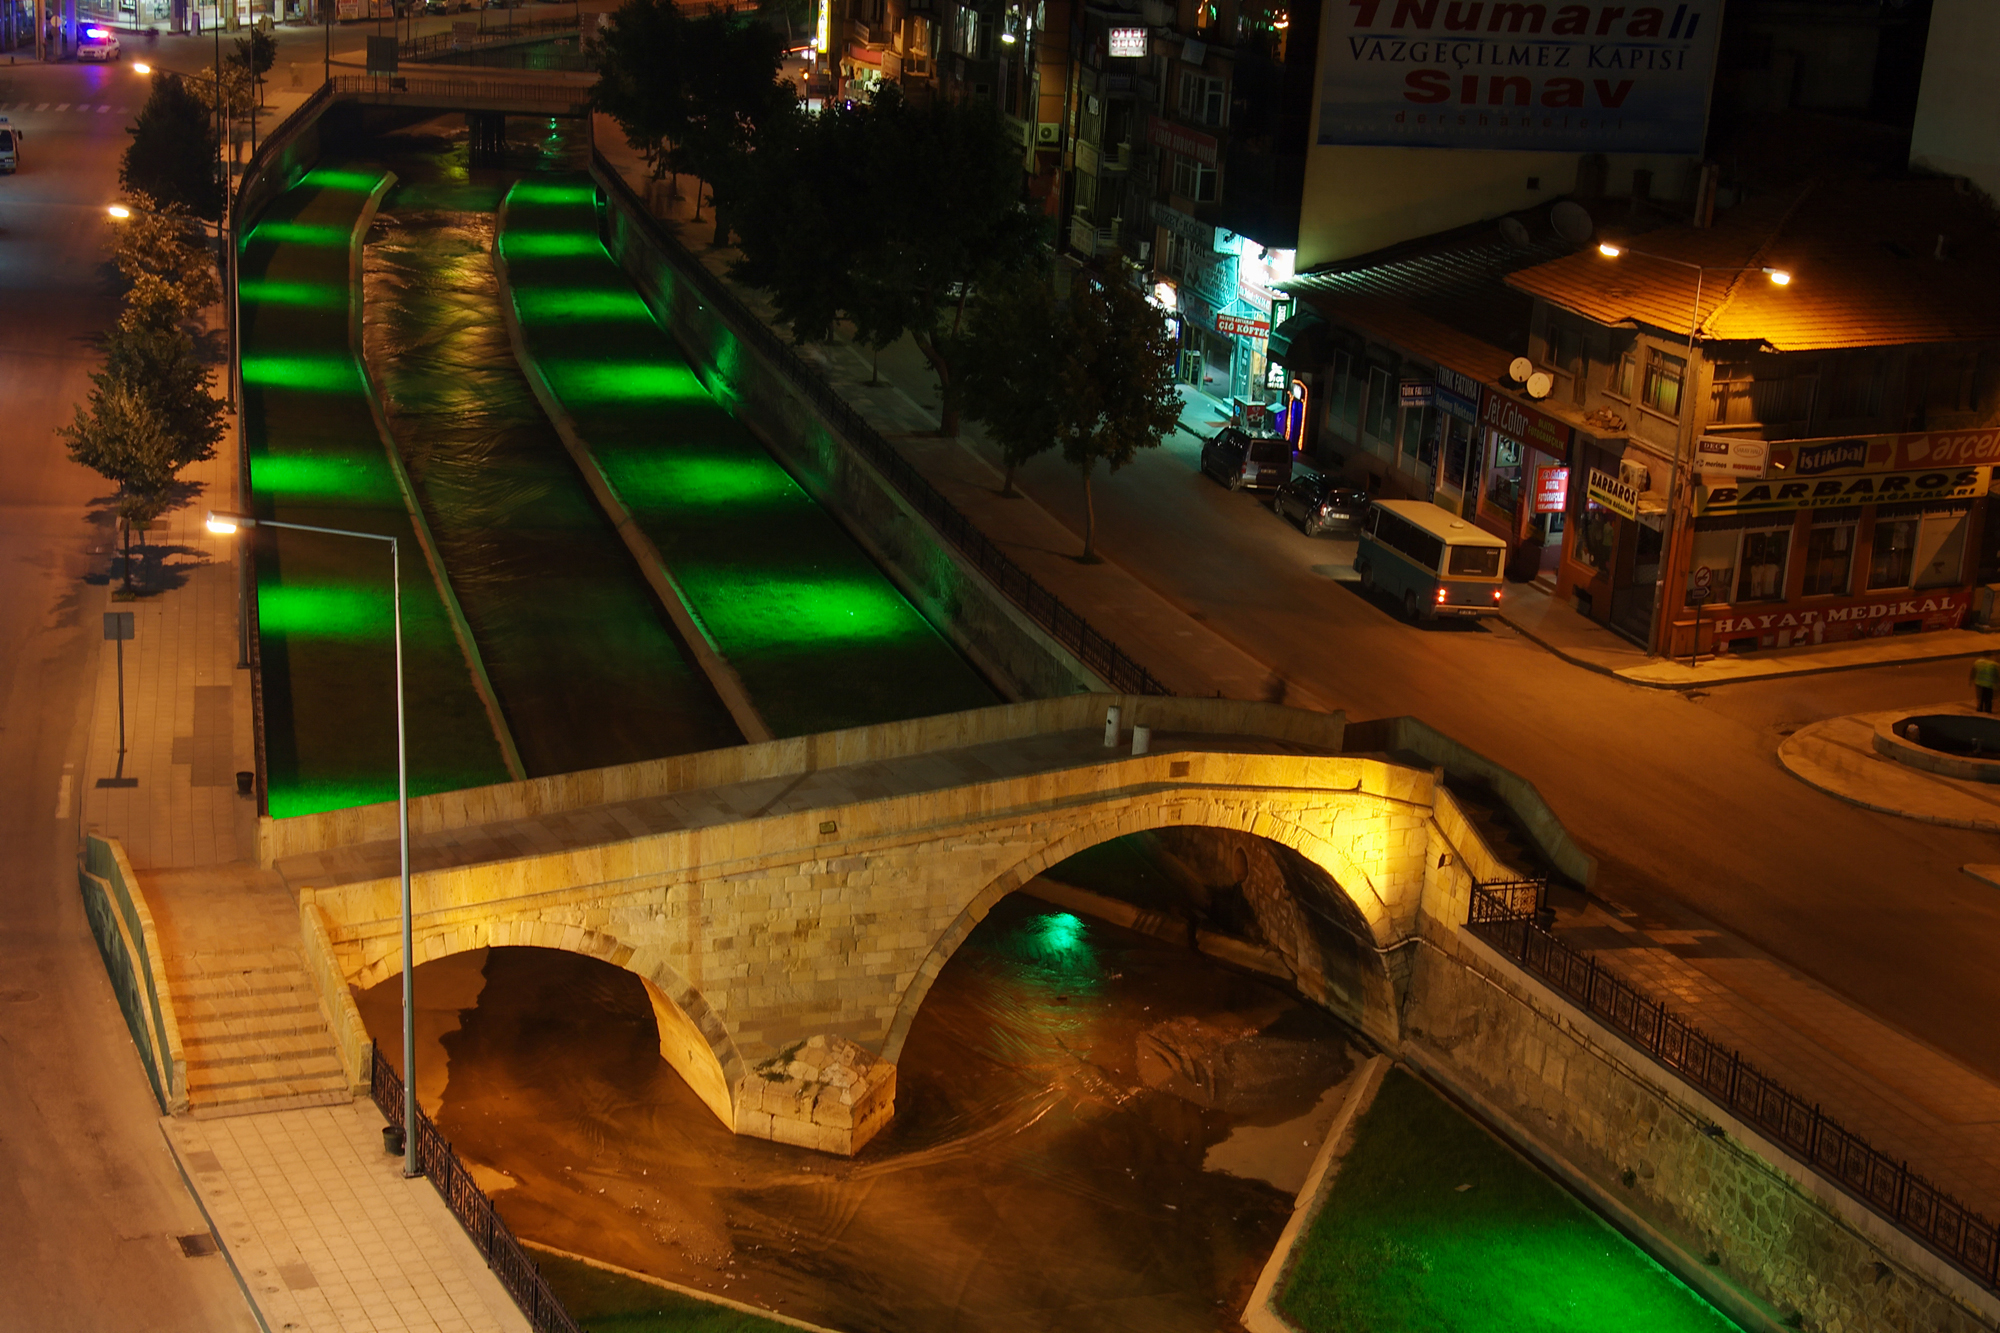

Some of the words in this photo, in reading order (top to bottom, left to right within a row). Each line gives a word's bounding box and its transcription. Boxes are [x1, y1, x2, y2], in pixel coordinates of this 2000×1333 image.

[1111, 28, 1147, 39] OTEL
[1347, 36, 1571, 70] VAZGEÇİLMEZ
[1402, 68, 1636, 109] sınav
[1394, 110, 1623, 130] dershaneleri
[1454, 373, 1478, 401] FATURA
[1500, 401, 1529, 437] Color
[1799, 444, 1864, 469] istikbal
[1591, 471, 1636, 506] BARBAROS
[1706, 470, 1979, 504] BARBAROS
[1797, 495, 1852, 508] GİYİM
[1713, 610, 1820, 634] HAYAT
